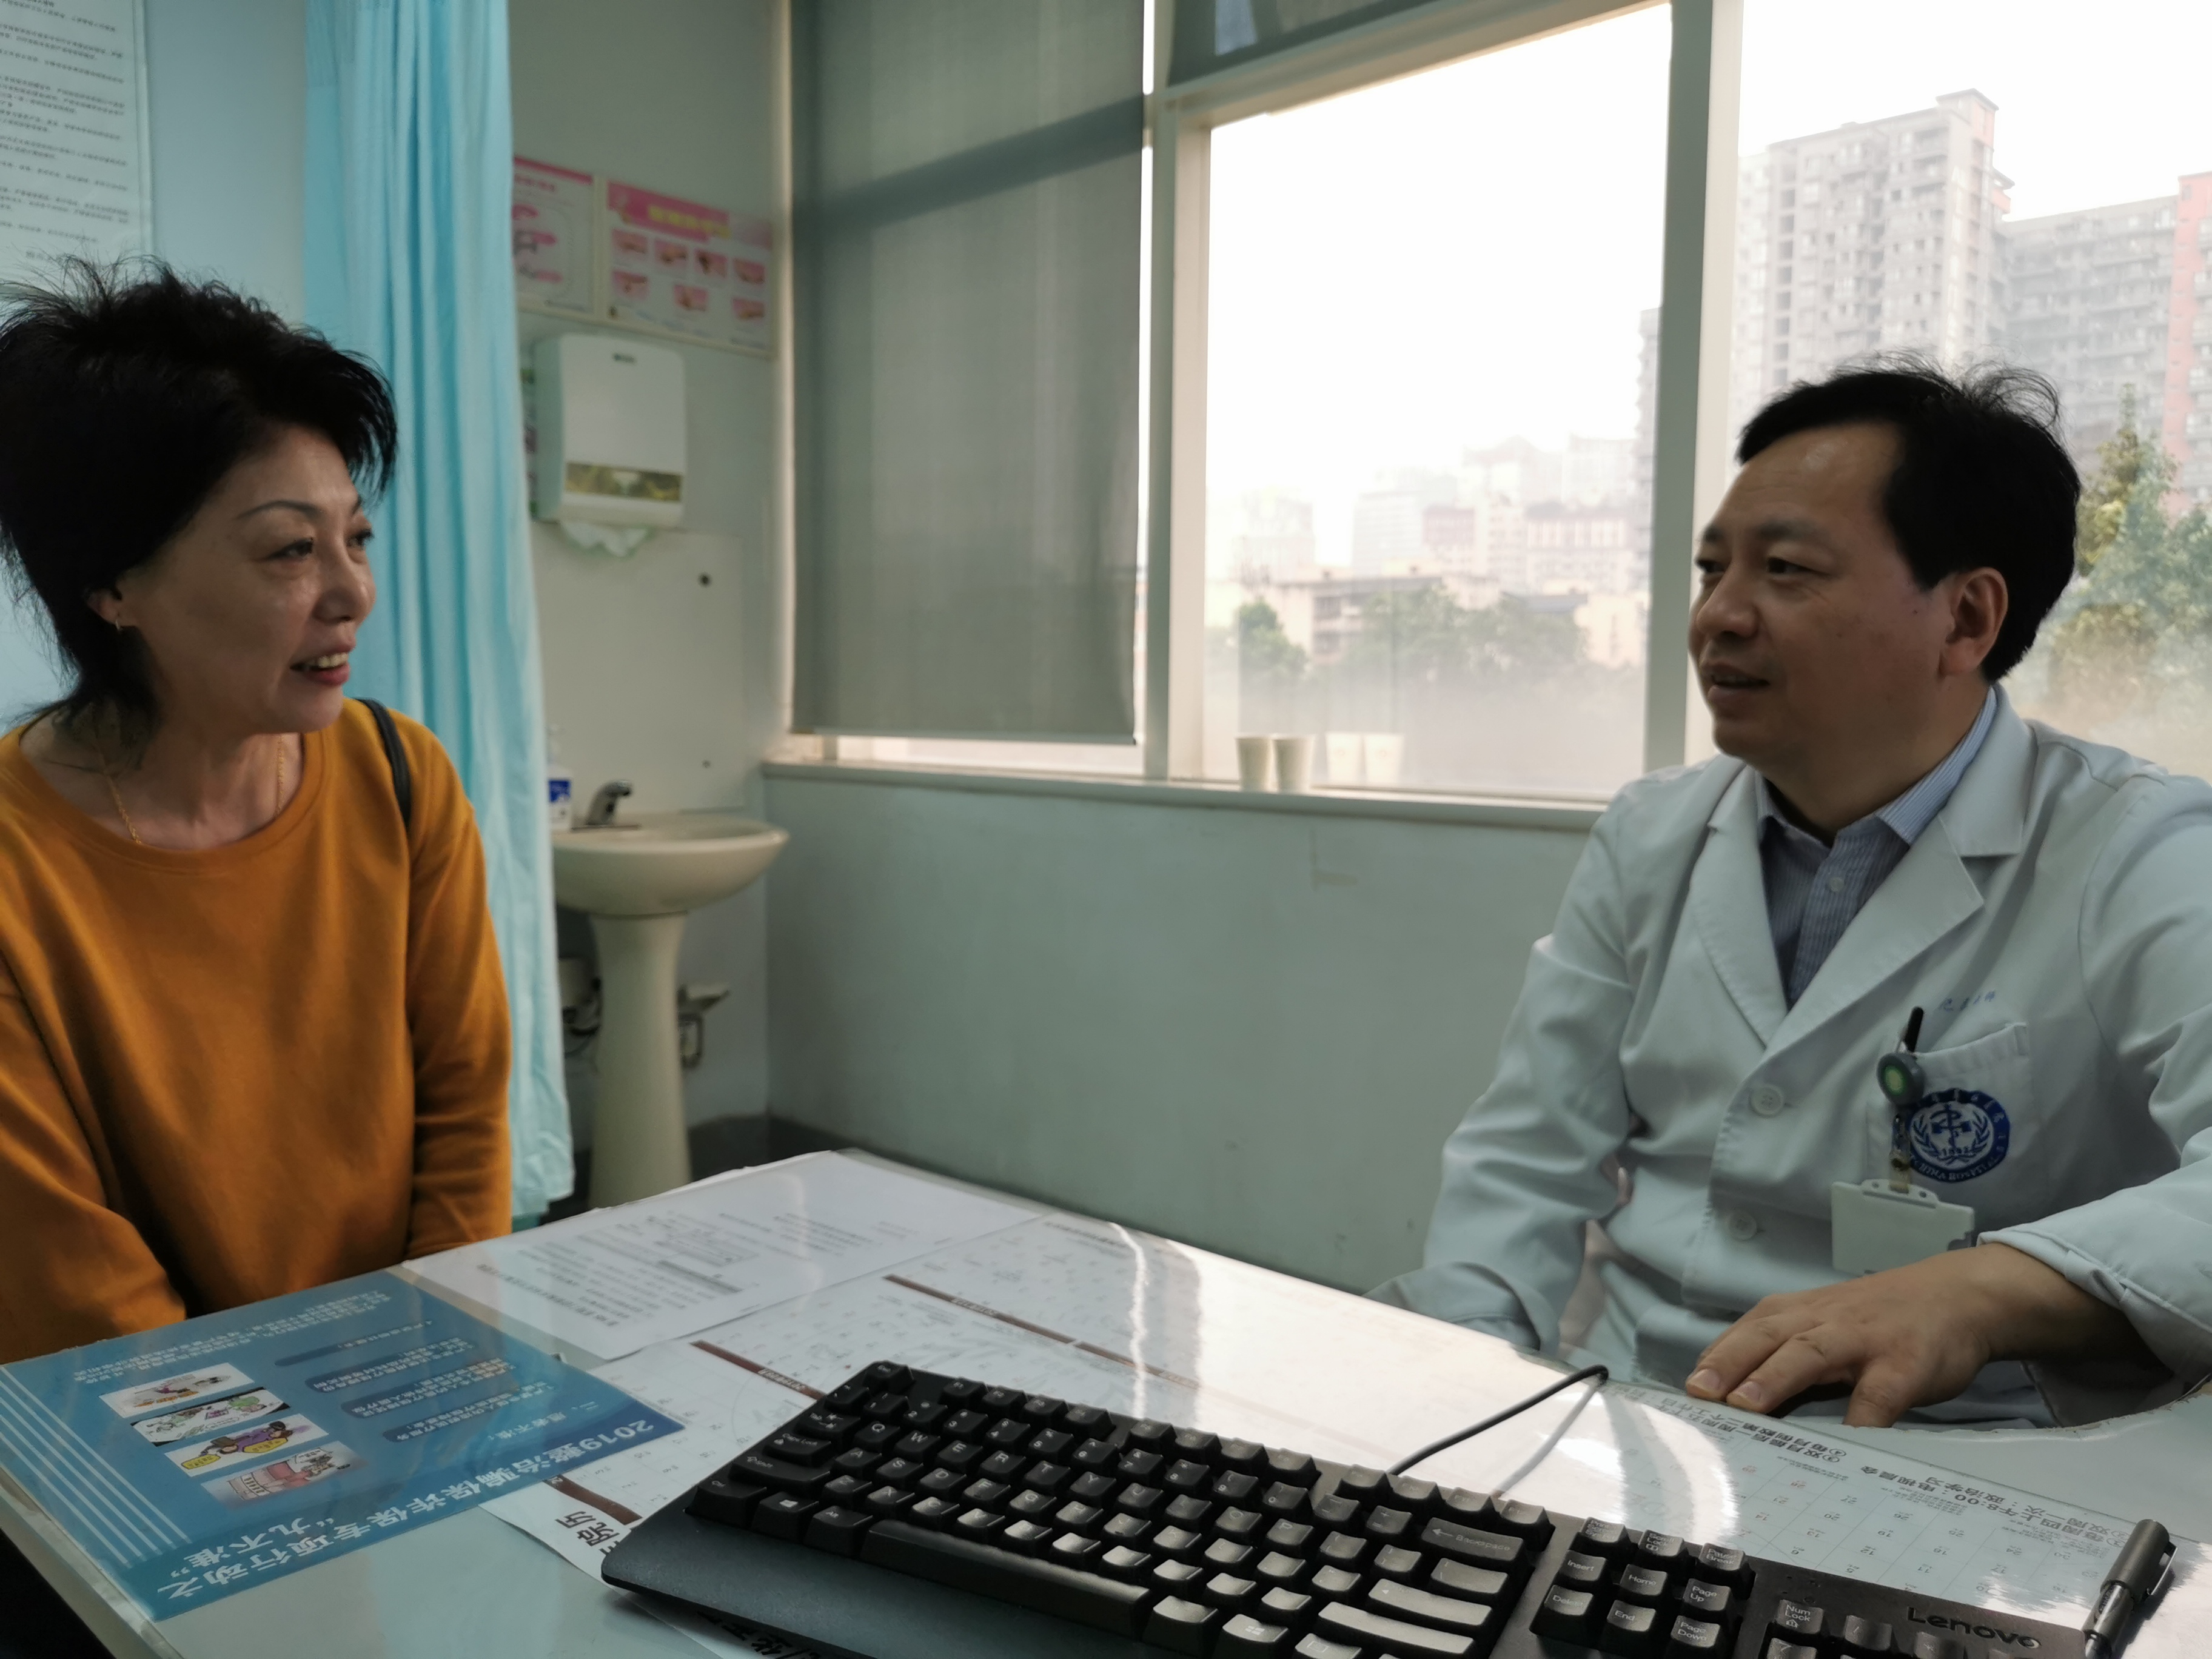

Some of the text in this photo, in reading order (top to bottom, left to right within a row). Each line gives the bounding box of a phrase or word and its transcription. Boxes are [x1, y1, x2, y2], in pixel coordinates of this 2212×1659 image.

[871, 1423, 886, 1433] Q
[911, 1432, 928, 1443] W
[953, 1443, 967, 1453] E
[1033, 1440, 1043, 1449] 5
[893, 1459, 907, 1468] S
[994, 1453, 1010, 1464] R
[1041, 1463, 1054, 1473] T
[935, 1470, 950, 1479] D
[1088, 1475, 1101, 1484] Y
[156, 1418, 655, 1601] 2019整治骗保诈保专项行动之
[1279, 1522, 1293, 1530] P
[1567, 1560, 1595, 1572] Insert
[1628, 1574, 1657, 1587] Home
[1692, 1586, 1717, 1598] Page
[1553, 1595, 1584, 1606] Delete
[1689, 1593, 1704, 1603] Up
[1786, 1604, 1811, 1617] Num
[1615, 1610, 1636, 1623] End
[1785, 1610, 1811, 1623] Lock
[1680, 1621, 1707, 1634] Page
[1907, 1606, 2042, 1649] Lenovo
[1677, 1629, 1708, 1642] Down
